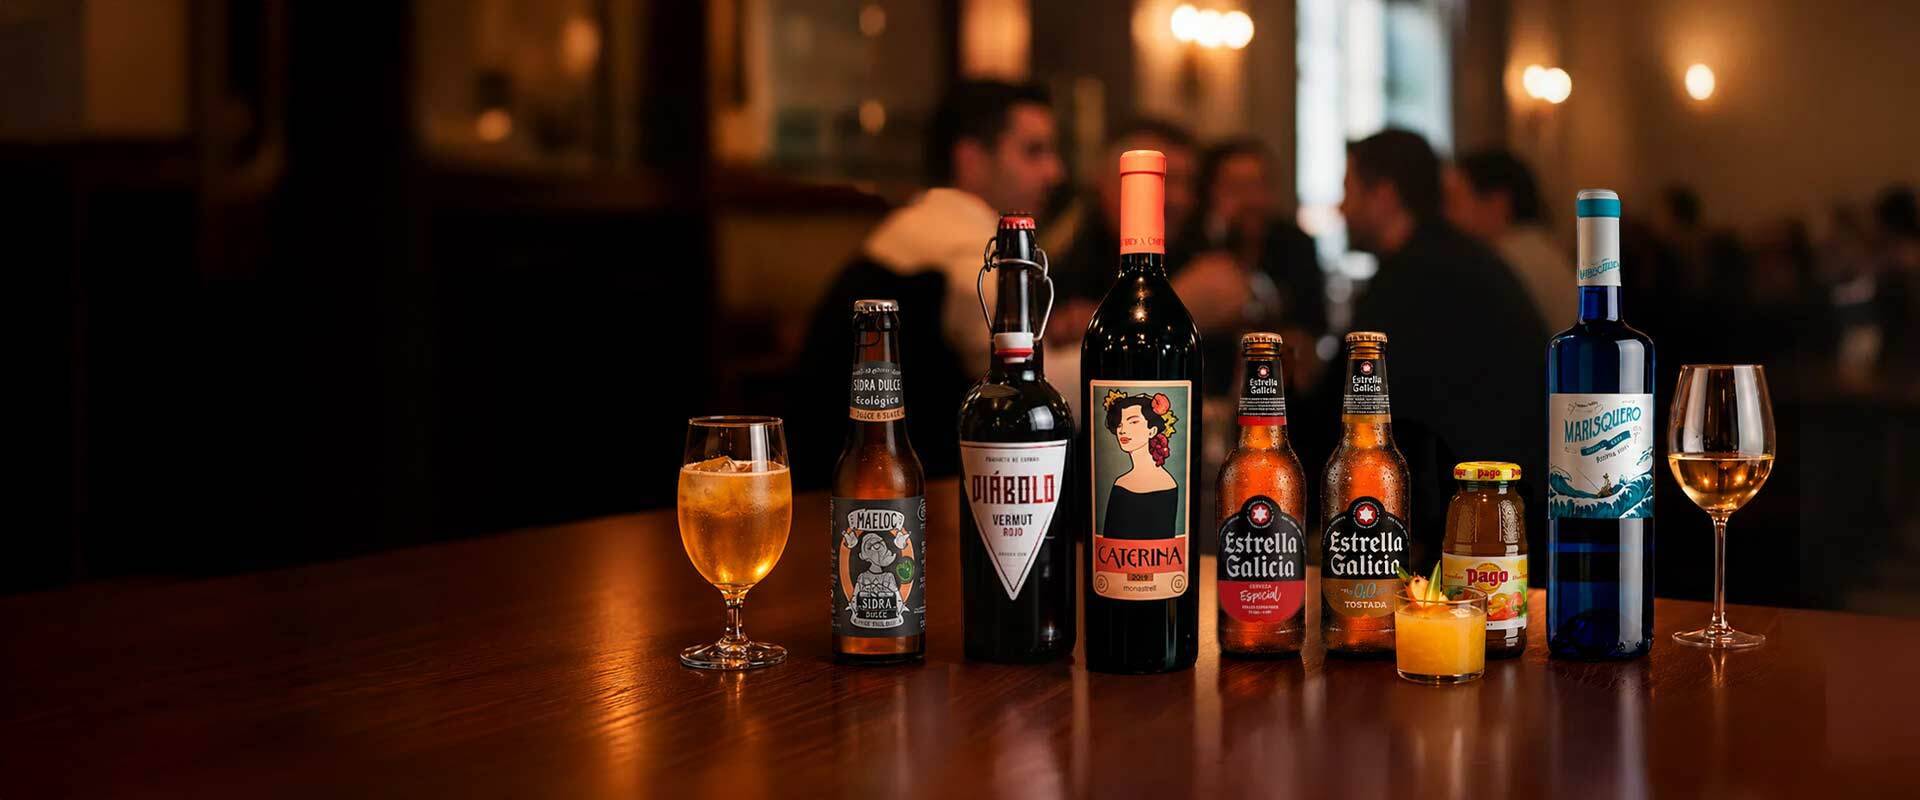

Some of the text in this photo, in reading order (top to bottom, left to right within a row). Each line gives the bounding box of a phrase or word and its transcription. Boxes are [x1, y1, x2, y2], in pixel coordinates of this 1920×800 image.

[853, 378, 901, 391] SIDRA DULCE
[1564, 406, 1641, 443] MARISQUERO
[972, 471, 1056, 504] DIÁBOLO
[857, 512, 898, 529] MAELOC
[992, 514, 1033, 526] VERMUT
[1003, 527, 1023, 537] ROJO
[1329, 531, 1403, 553] Estrella
[1224, 531, 1297, 554] Estrella
[1098, 545, 1182, 569] CATERINA
[1226, 554, 1295, 578] Galicia
[1330, 554, 1400, 576] Galicia
[862, 598, 892, 609] SIDRA
[1240, 586, 1281, 604] Especial
[1344, 600, 1387, 609] TOSTADA
